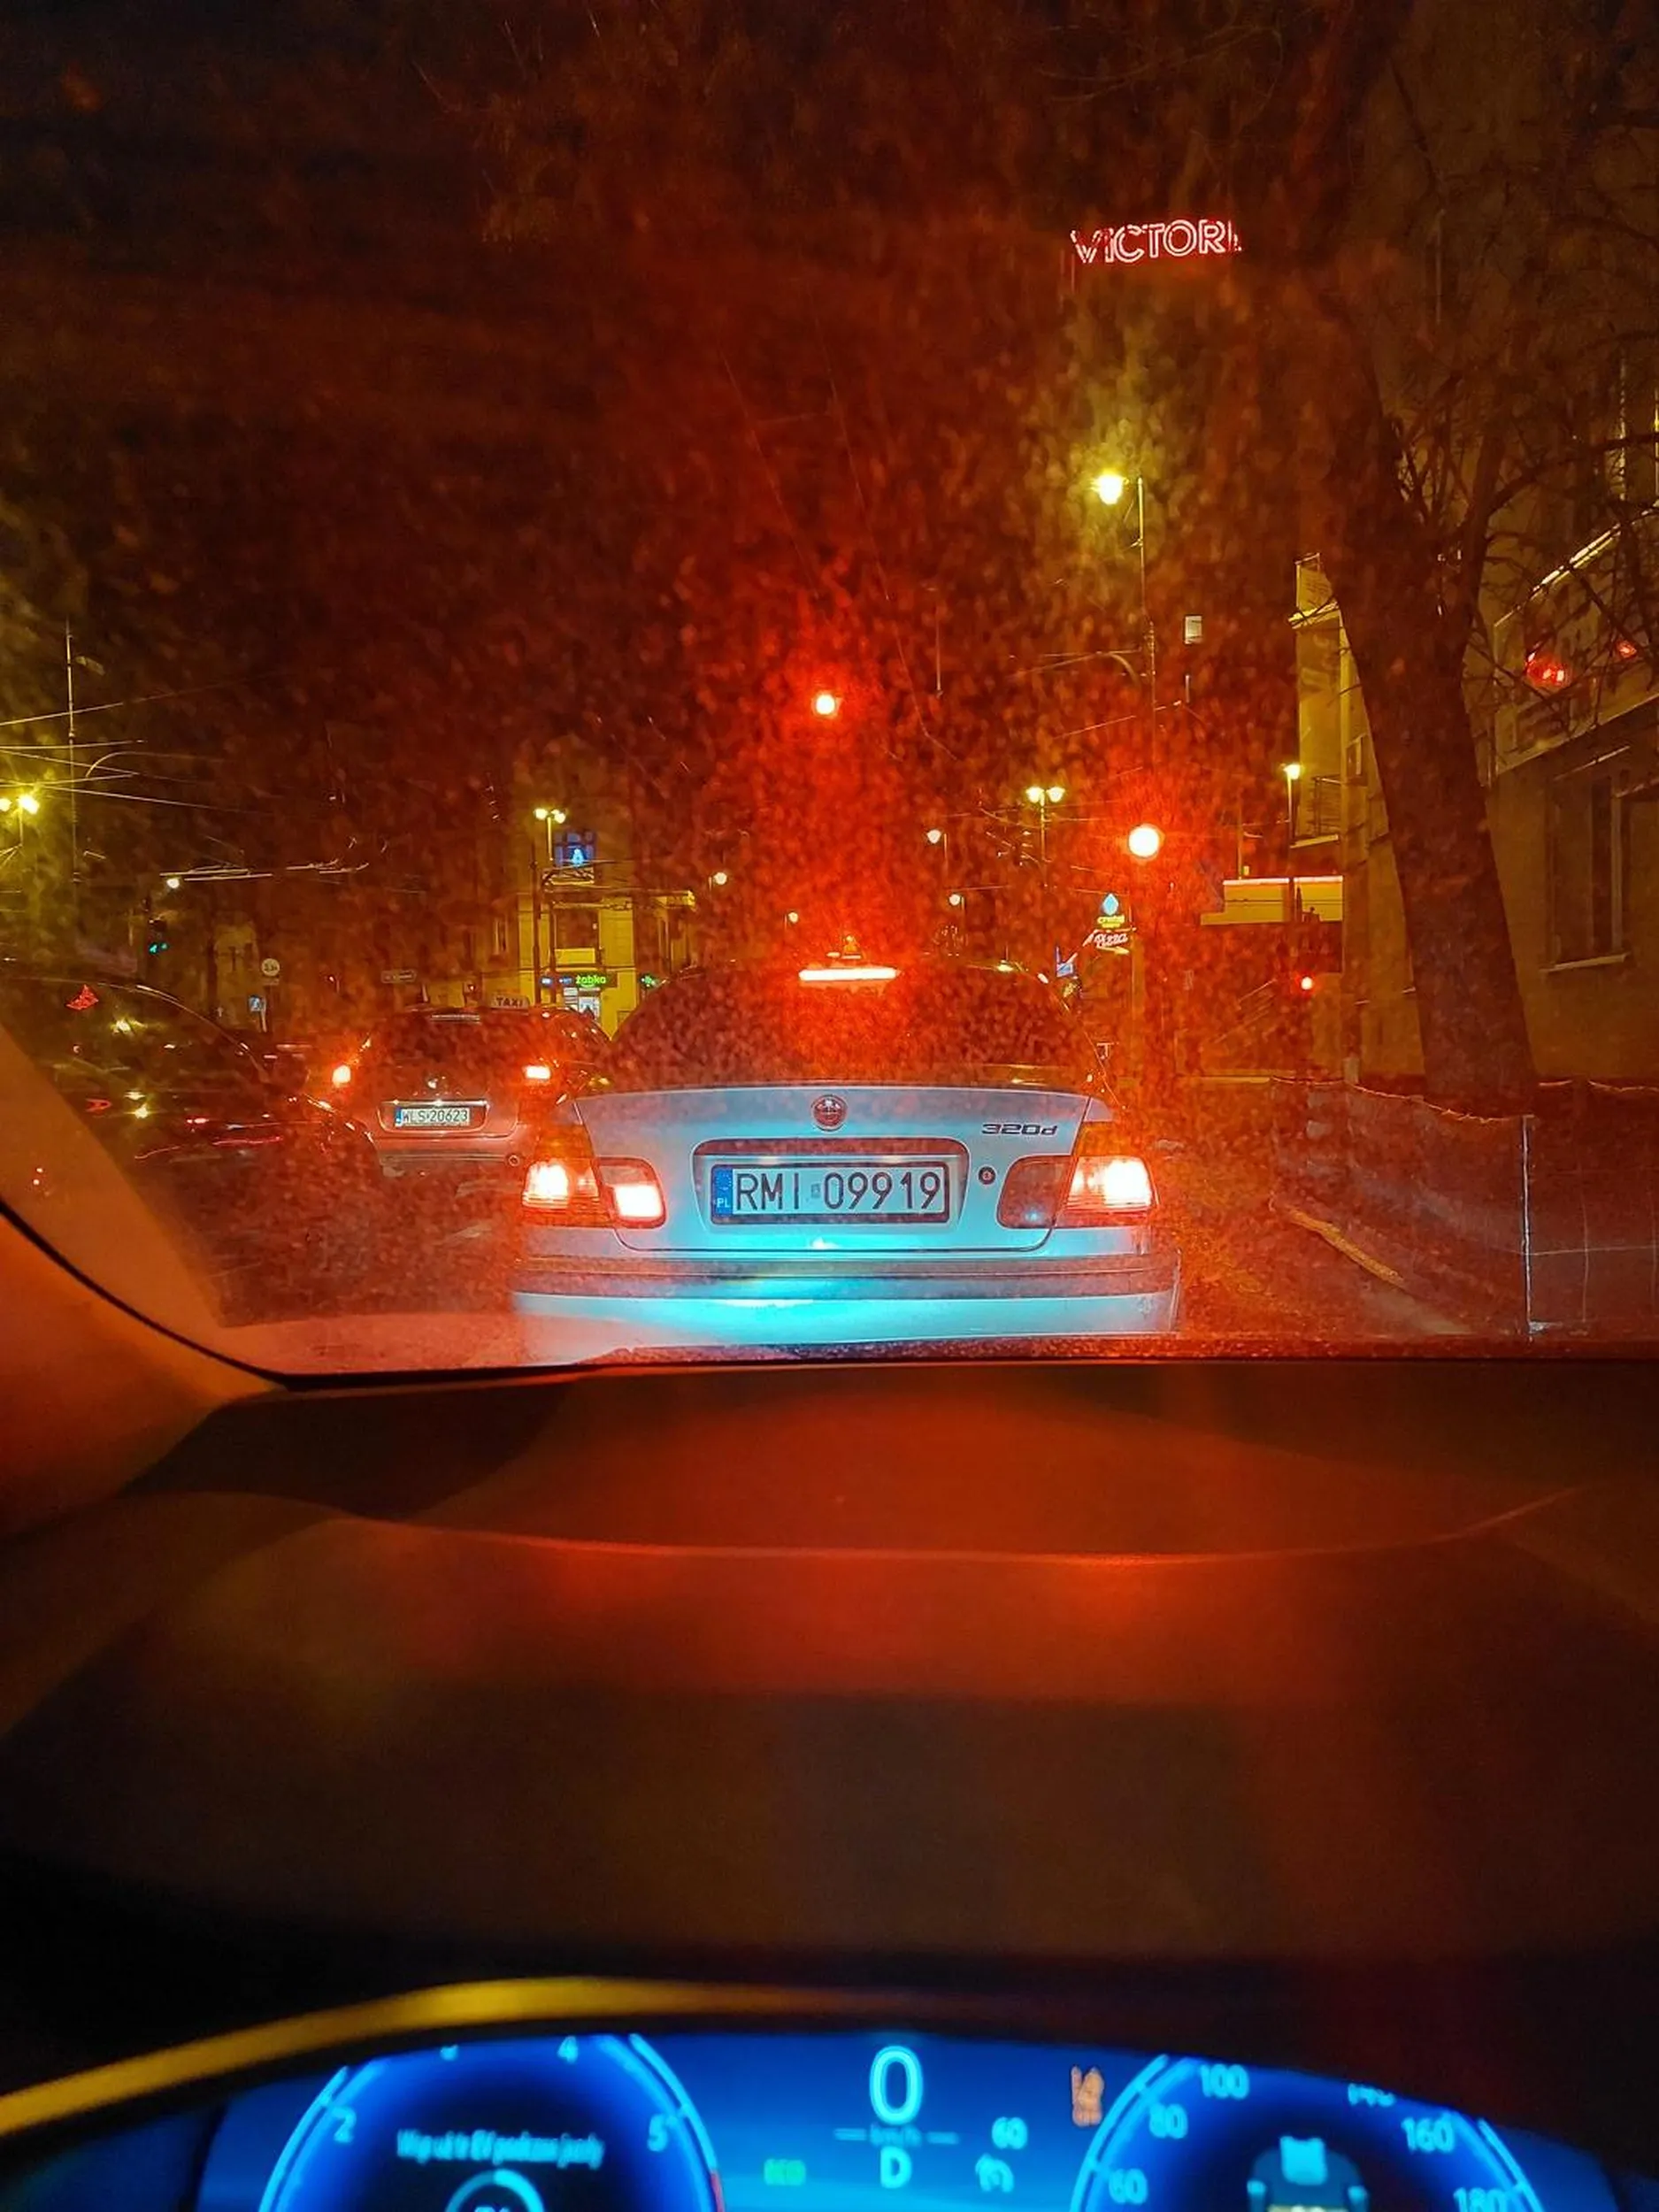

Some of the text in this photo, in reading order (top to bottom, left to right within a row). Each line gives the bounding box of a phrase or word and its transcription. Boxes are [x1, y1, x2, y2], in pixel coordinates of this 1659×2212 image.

[1070, 219, 1242, 264] VICTORI
[495, 996, 524, 1007] TAXI
[430, 1110, 468, 1123] 20623
[981, 1123, 1058, 1136] 320d
[717, 1197, 731, 1208] PL
[735, 1171, 941, 1211] RMI 09919
[557, 2036, 580, 2064] 4
[1200, 2063, 1250, 2101] 100
[332, 2107, 357, 2143] 2
[648, 2114, 672, 2153] 5
[1149, 2102, 1189, 2139] 80
[1401, 2116, 1455, 2153] 160
[880, 2145, 913, 2189] D
